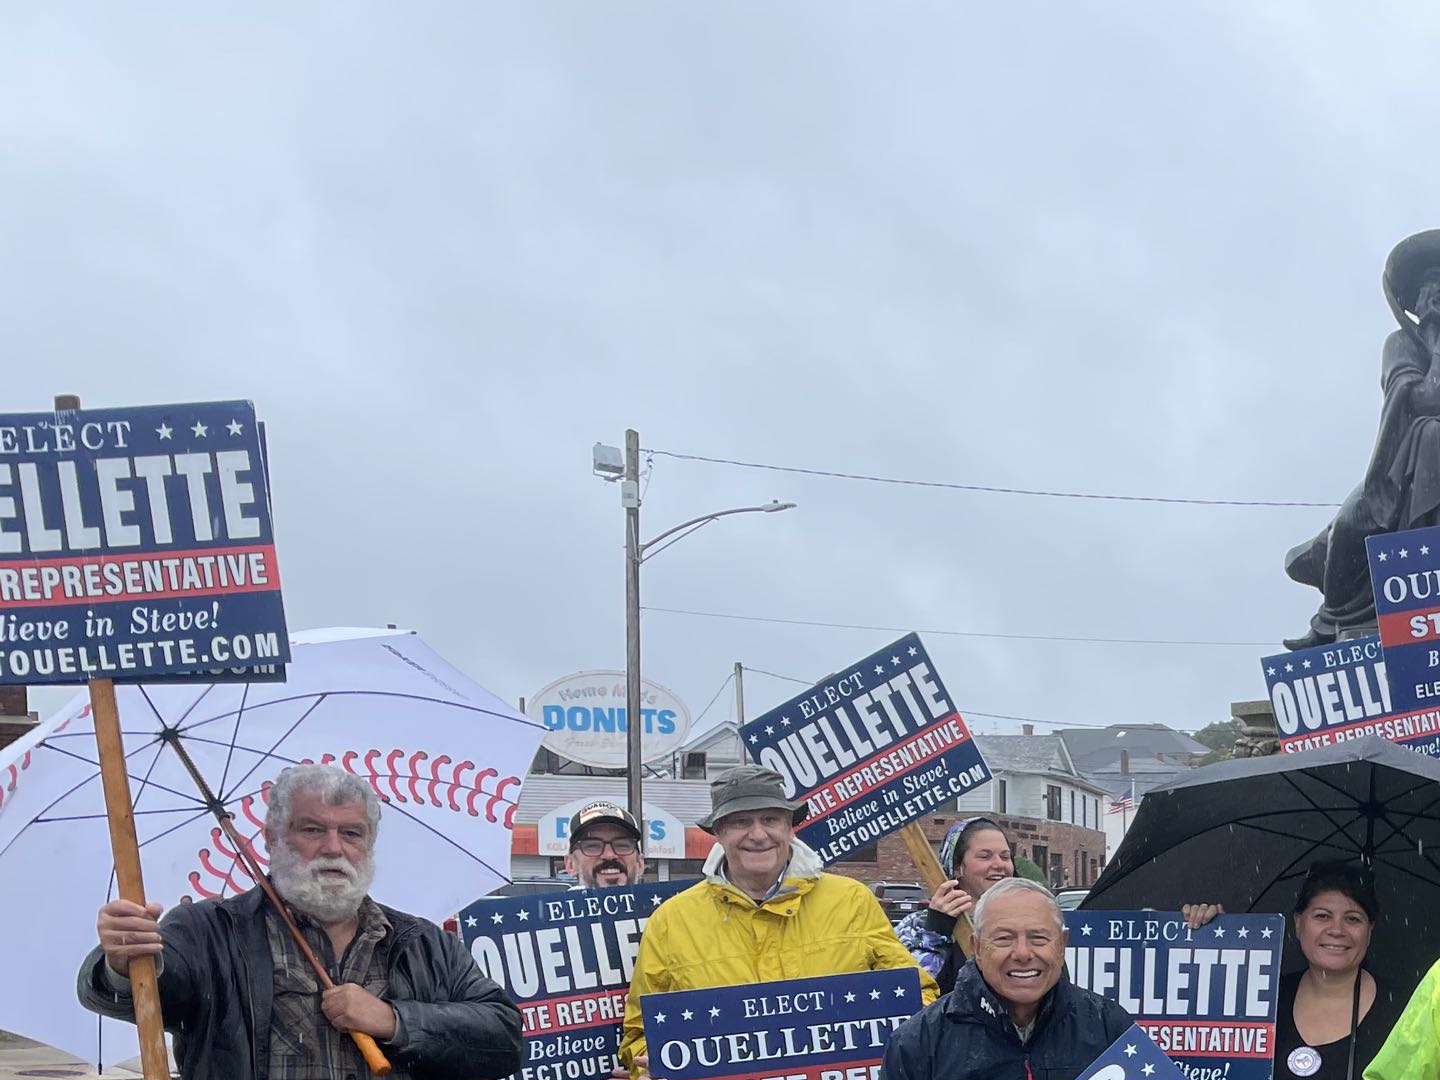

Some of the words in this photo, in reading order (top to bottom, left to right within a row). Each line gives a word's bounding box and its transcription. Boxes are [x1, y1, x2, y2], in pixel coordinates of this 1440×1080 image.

[0, 420, 131, 454] ELECT
[0, 449, 261, 553] ELLETTE
[0, 552, 268, 601] REPRESENTATIVE
[0, 615, 69, 642] lieve
[85, 609, 114, 638] in
[130, 600, 220, 635] Steve!
[0, 631, 281, 678] OUELLETTE.COM
[1322, 641, 1382, 669] ELEC
[798, 672, 866, 719] ELECT
[1271, 662, 1392, 735] OUELL
[760, 661, 950, 799] OUELLETTE
[806, 788, 837, 820] ATE
[834, 719, 964, 802] REPRESENTATIVE
[816, 764, 986, 862] LECTOUELLETTE.COM
[826, 799, 880, 836] Believe
[883, 788, 900, 804] in
[903, 757, 949, 795] Steve!
[546, 894, 636, 922] ELECT
[1108, 919, 1195, 942] ELECT
[471, 917, 649, 998] OUELLE
[743, 991, 826, 1018] ELECT
[1064, 947, 1273, 1017] UELLETTE
[528, 1035, 605, 1061] Believe
[1140, 1026, 1268, 1053] ESENTATIVE
